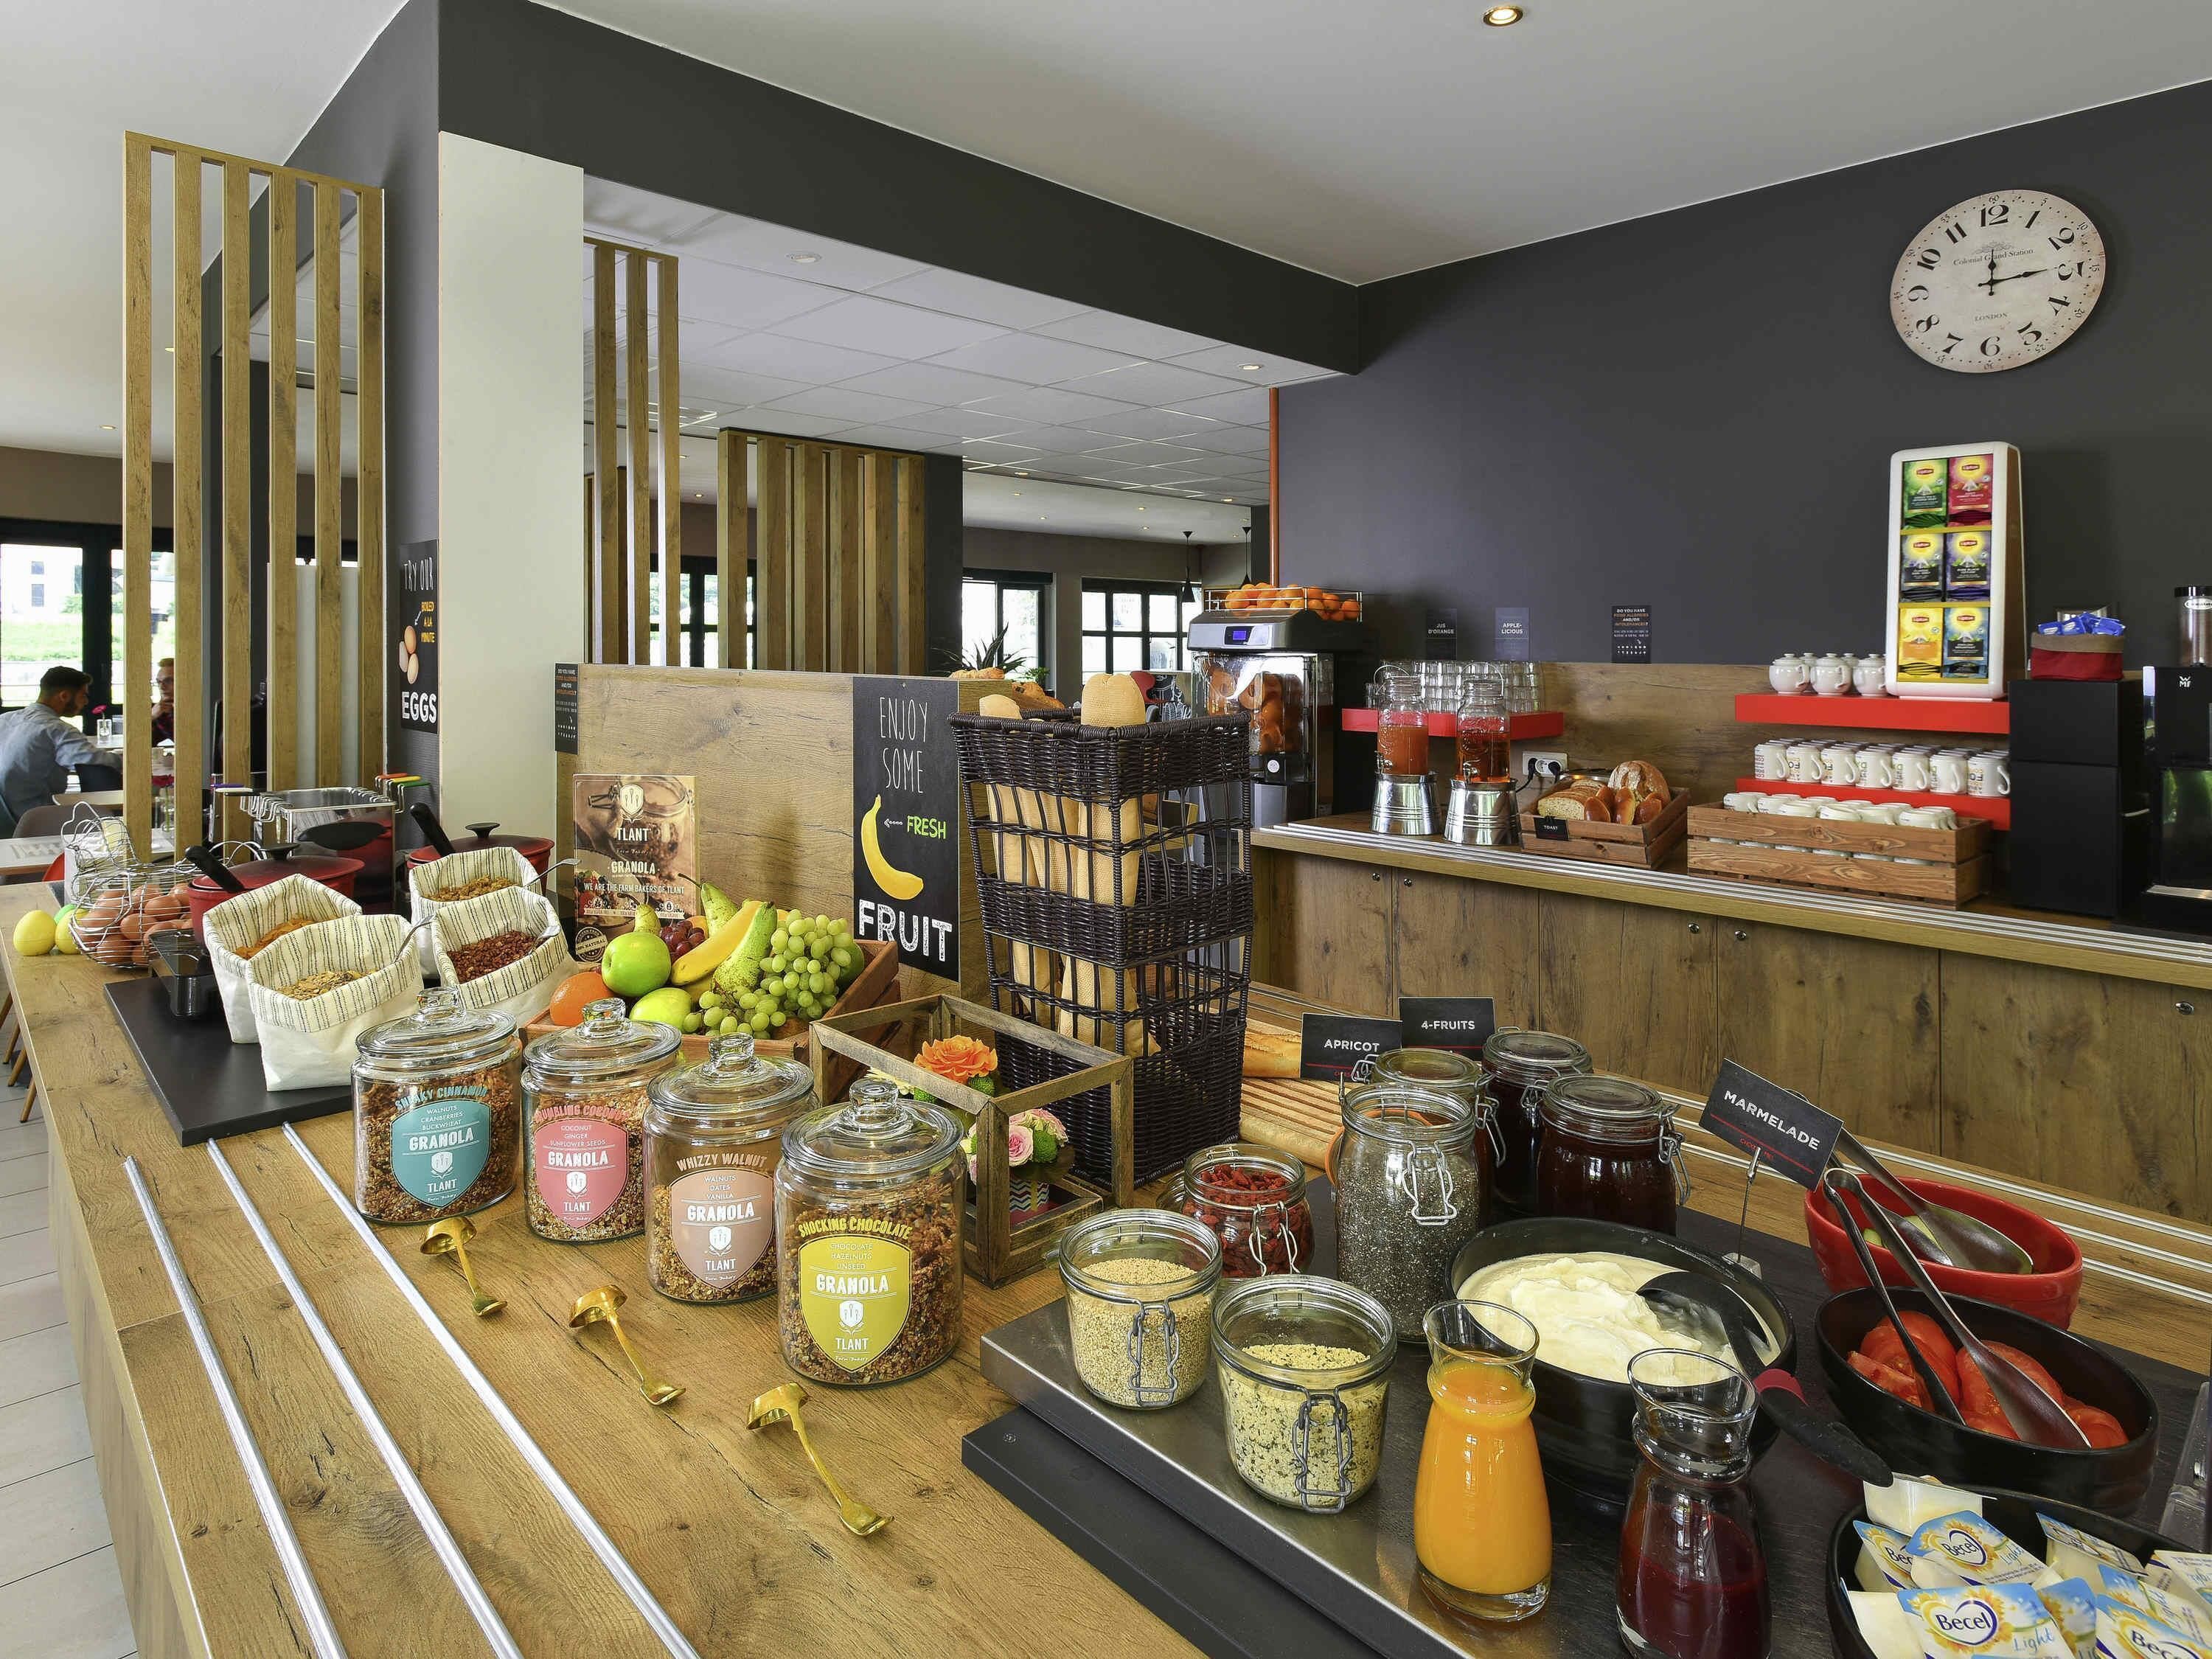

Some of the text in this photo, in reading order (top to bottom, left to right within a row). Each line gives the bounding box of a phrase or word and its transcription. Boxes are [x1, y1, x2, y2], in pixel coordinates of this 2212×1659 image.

[1980, 204, 2009, 227] 12
[2025, 210, 2041, 229] 1
[1944, 222, 1967, 245] 11
[2048, 226, 2075, 251] 2
[1917, 248, 1941, 271] 10
[1984, 251, 2007, 260] Gand
[2008, 249, 2034, 257] Station
[2058, 261, 2084, 282] 3
[1907, 285, 1930, 302] 9
[2048, 296, 2071, 316] 4
[1916, 313, 1941, 333] 8
[1975, 312, 2008, 322] LONDON
[1942, 332, 1964, 354] 7
[2017, 321, 2042, 346] 5
[1980, 335, 2000, 357] 6
[404, 557, 434, 591] TRY OUR
[402, 691, 438, 724] EGGS
[879, 697, 928, 743] ENJOY
[883, 747, 924, 794] SOME
[616, 827, 649, 841] TLANT
[907, 815, 947, 840] FRESH
[611, 860, 655, 874] GRANOLA
[594, 883, 605, 891] ARE
[607, 883, 618, 891] THE
[619, 884, 633, 893] FARM
[635, 885, 657, 894] BAKERS
[658, 886, 665, 894] OF
[667, 886, 684, 894] TLANT
[858, 899, 953, 962] FRUIT
[1421, 1020, 1475, 1030] 4-FRUITS
[1324, 1038, 1380, 1052] APRICOT
[420, 1111, 465, 1124] CRANBERRIES
[426, 1105, 458, 1115] WALNUTS
[422, 1119, 462, 1132] BUCKWHEAT
[1724, 1090, 1820, 1151] MARMELADE
[409, 1127, 474, 1151] GRANOLA
[548, 1150, 608, 1167] GRANOLA
[676, 1153, 767, 1172] WHIZZY WALNUT
[428, 1178, 457, 1193] TLANT
[563, 1201, 591, 1212] TLANT
[687, 1202, 755, 1222] GRANOLA
[798, 1217, 913, 1240] SHOCKING CHOCOLATE
[705, 1259, 736, 1271] TLANT
[815, 1273, 889, 1295] GRANOLA
[835, 1338, 869, 1350] TLANT
[1941, 1538, 1978, 1557] Becel
[2000, 1543, 2025, 1569] Light
[1935, 1612, 1992, 1631] Becel
[2013, 1627, 2054, 1653] Light
[2132, 1630, 2178, 1659] Bec
